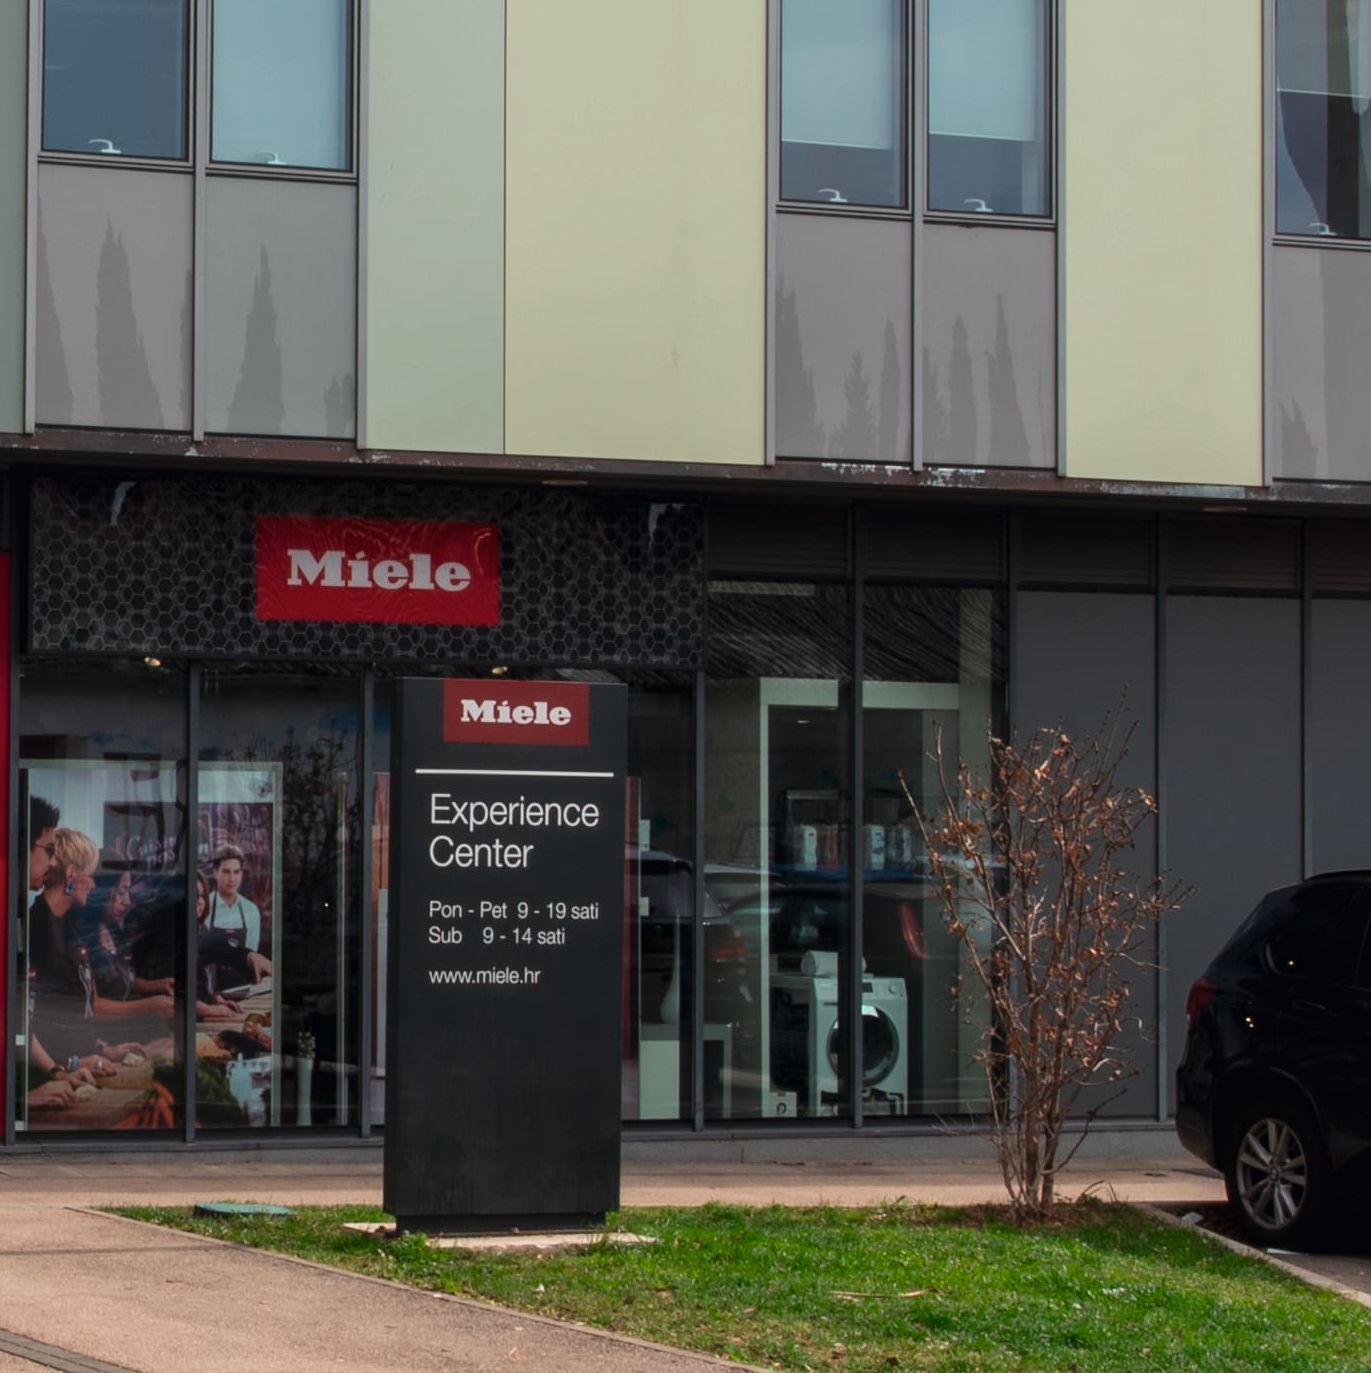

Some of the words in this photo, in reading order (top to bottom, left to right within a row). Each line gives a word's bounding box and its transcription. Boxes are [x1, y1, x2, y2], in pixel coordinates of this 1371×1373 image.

[287, 548, 471, 592] Miele
[460, 699, 572, 726] Miele
[430, 793, 600, 832] Experience
[428, 835, 534, 868] Center
[429, 900, 463, 918] Pon
[479, 901, 508, 919] Pet
[517, 901, 529, 919] 9
[546, 902, 567, 920] 19
[571, 902, 599, 920] sati
[428, 926, 463, 944] Sub
[482, 927, 495, 944] 9
[512, 928, 532, 945] 14
[537, 928, 566, 945] sati
[428, 966, 542, 984] www.miele.hr
